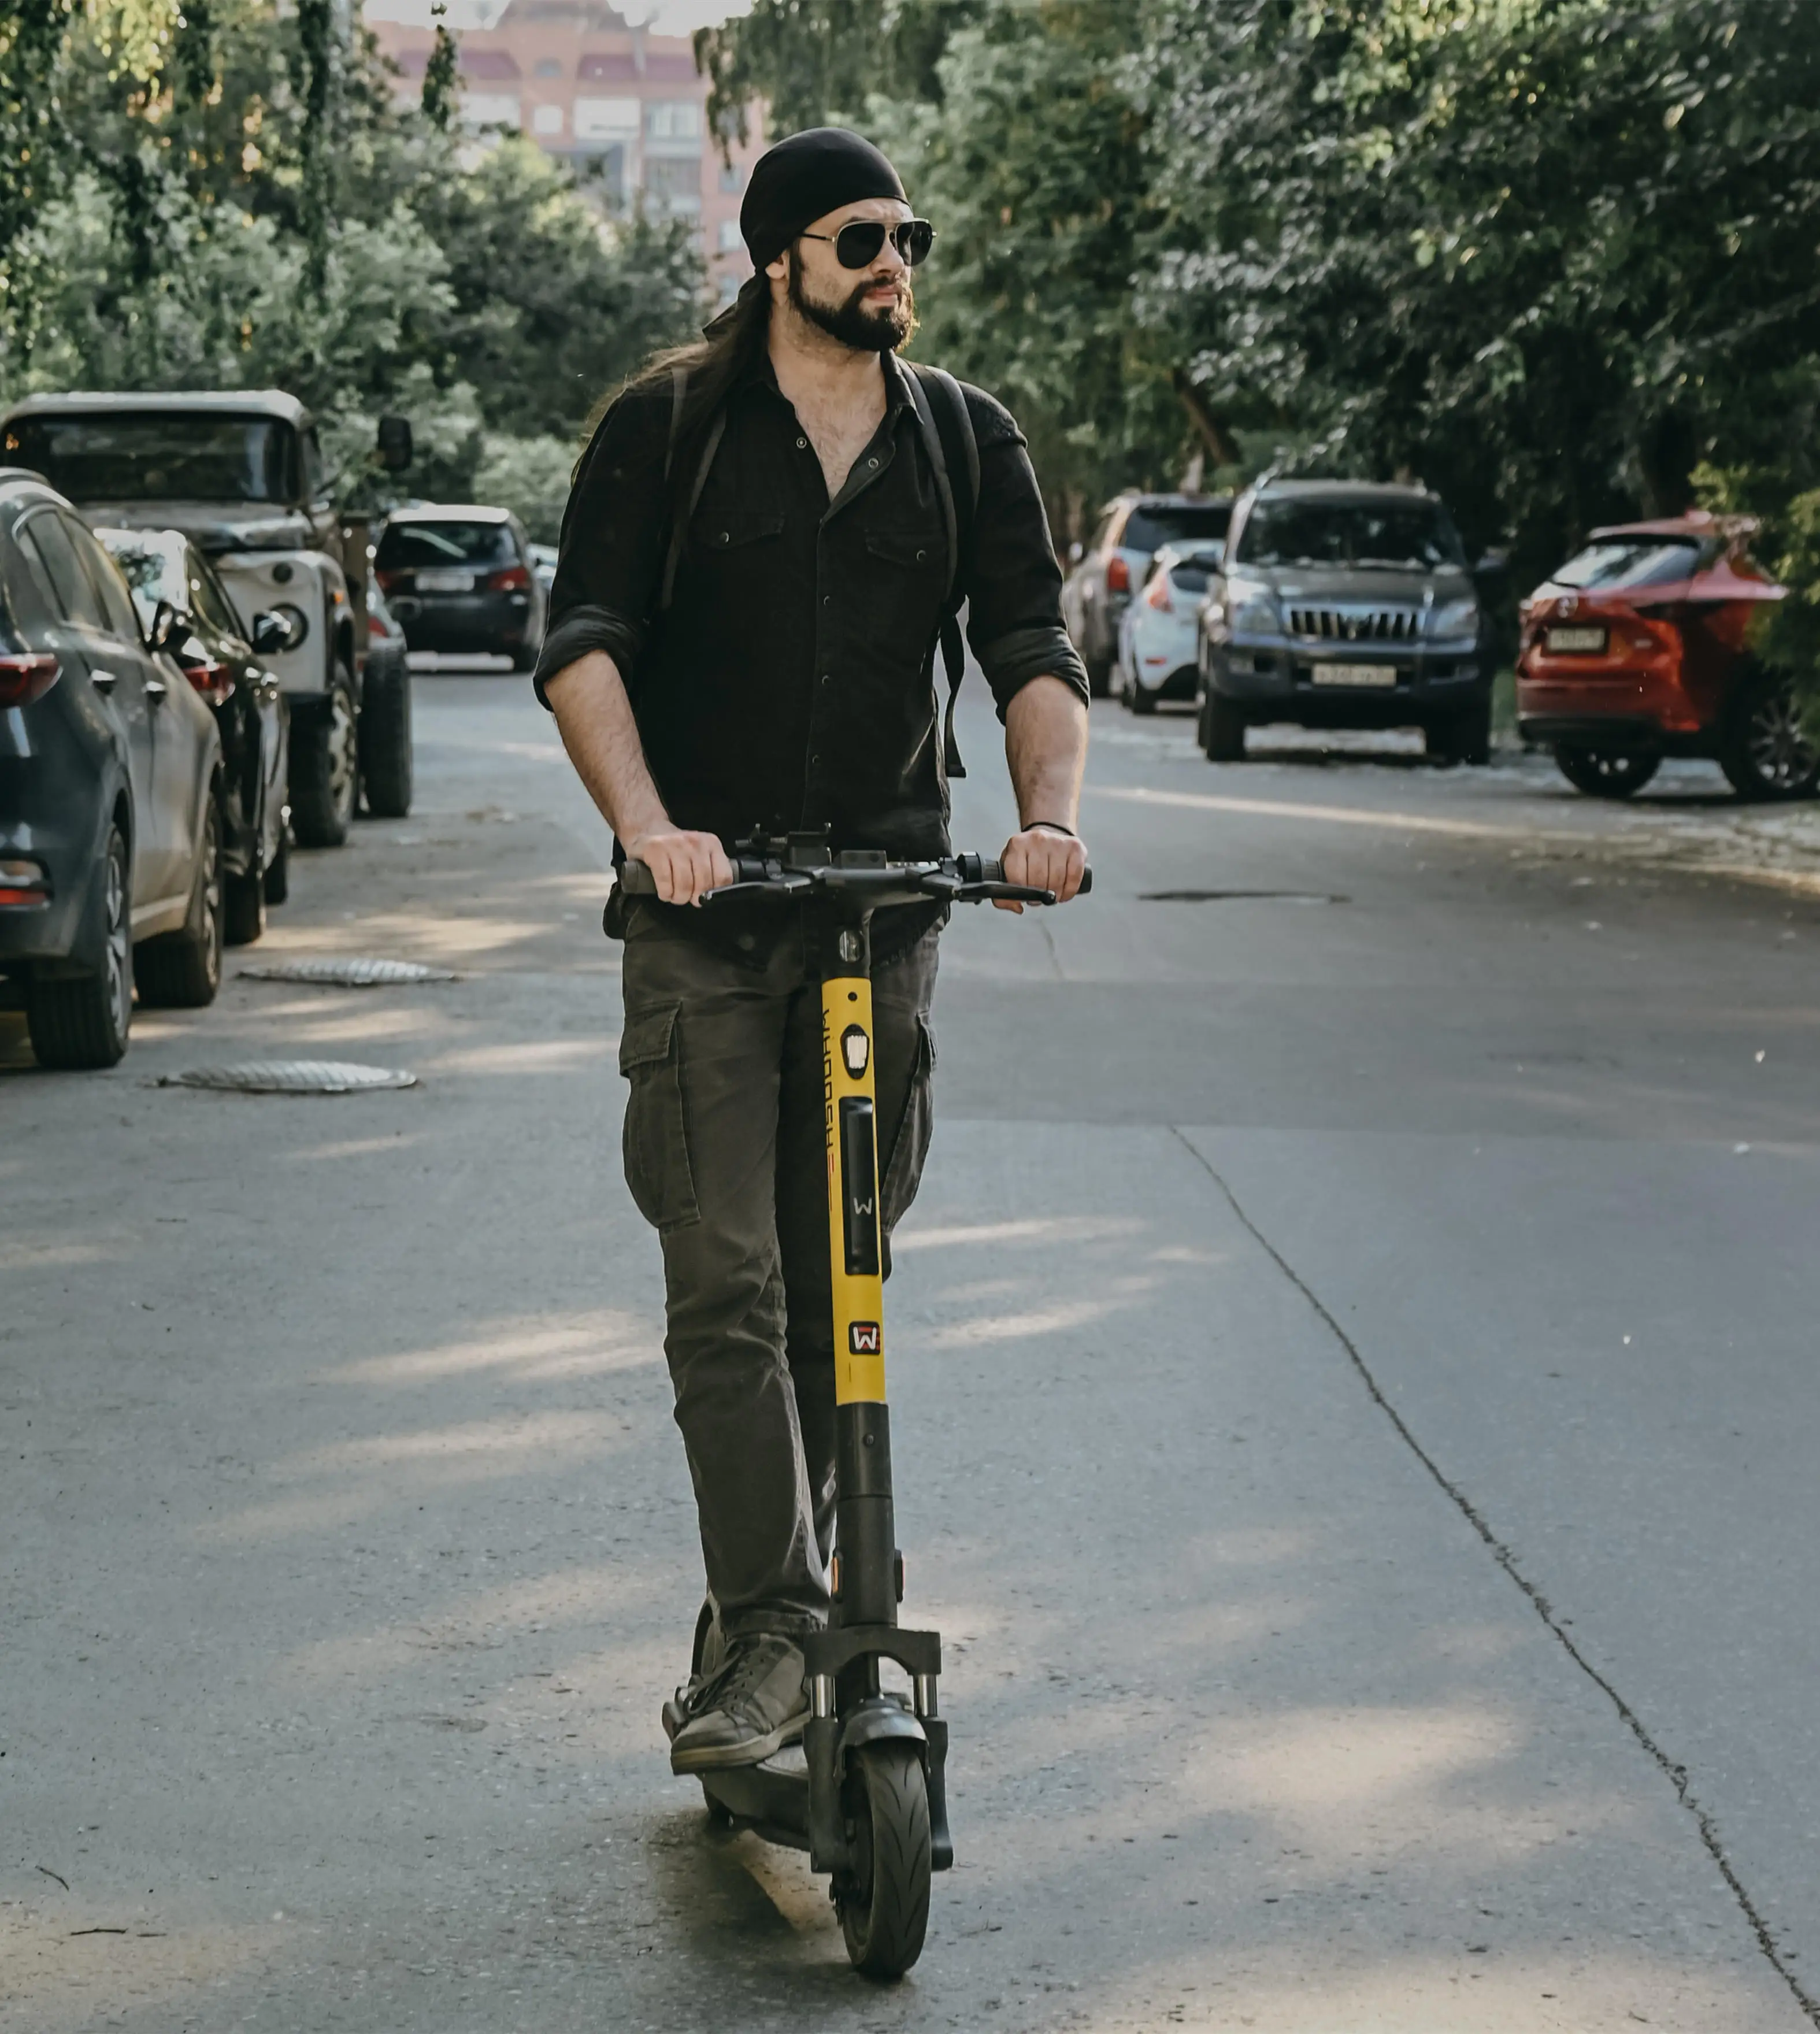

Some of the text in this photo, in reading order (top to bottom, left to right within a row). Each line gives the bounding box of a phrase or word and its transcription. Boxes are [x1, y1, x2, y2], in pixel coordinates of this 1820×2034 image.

[822, 1009, 833, 1149] WHOOSH
[854, 1197, 872, 1214] W
[853, 1327, 877, 1350] W
